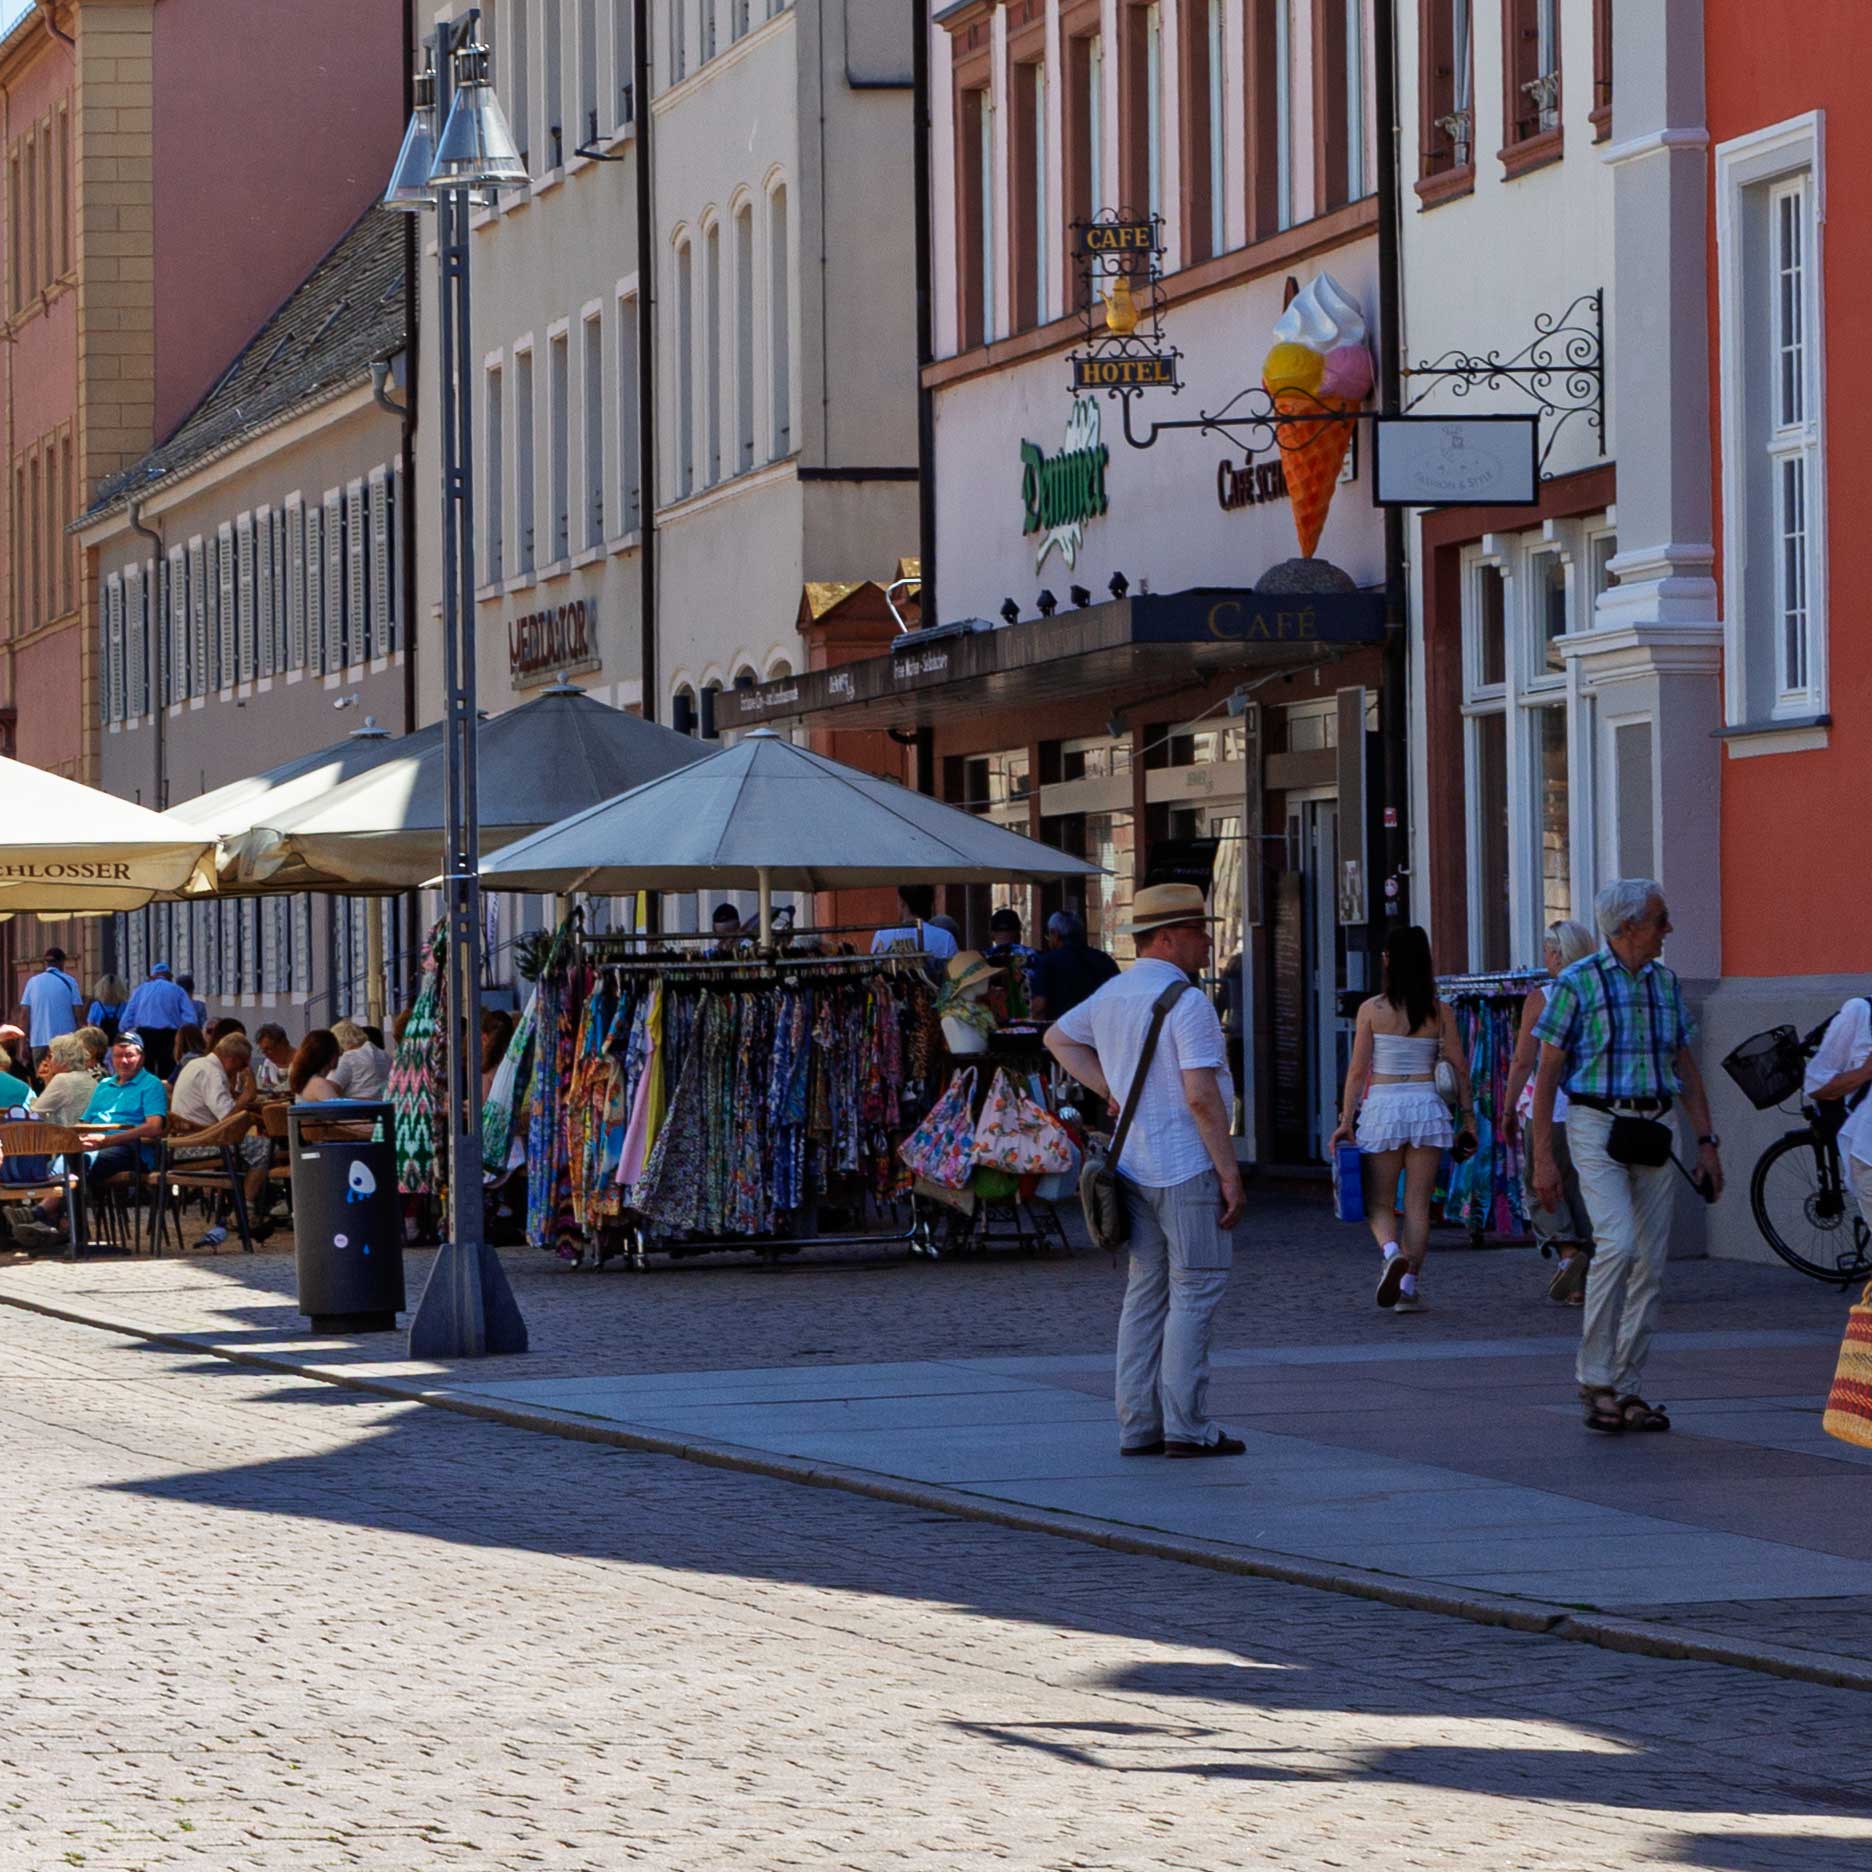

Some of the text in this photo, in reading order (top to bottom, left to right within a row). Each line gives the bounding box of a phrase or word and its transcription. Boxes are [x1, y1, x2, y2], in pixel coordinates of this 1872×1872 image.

[1086, 226, 1150, 250] CAFE
[1081, 360, 1170, 385] HOTEL
[1207, 601, 1316, 640] CAFÉ
